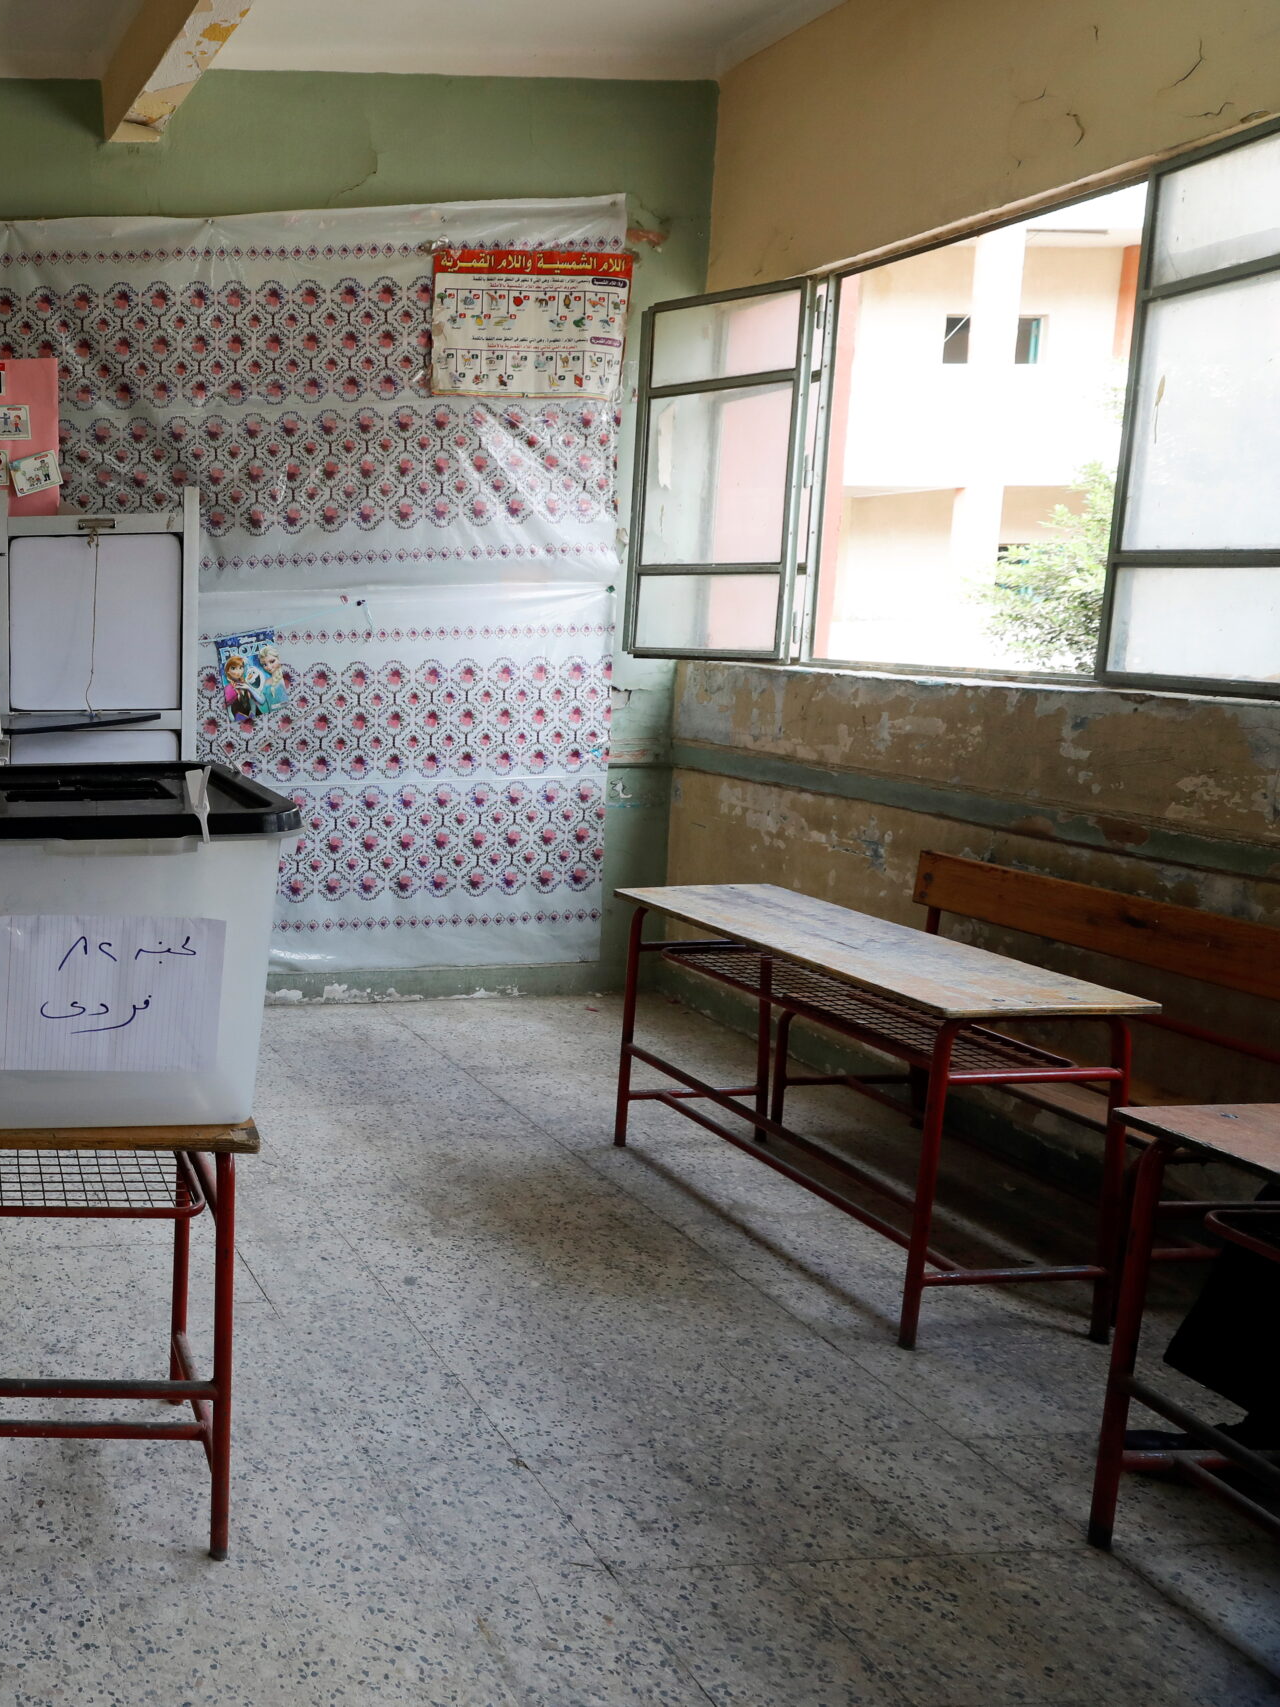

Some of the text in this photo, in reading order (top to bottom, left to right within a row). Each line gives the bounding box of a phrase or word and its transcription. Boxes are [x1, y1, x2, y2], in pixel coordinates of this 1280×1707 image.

[440, 254, 625, 273] اللام الشمسية واللام القمرية
[219, 641, 275, 663] FROZ
